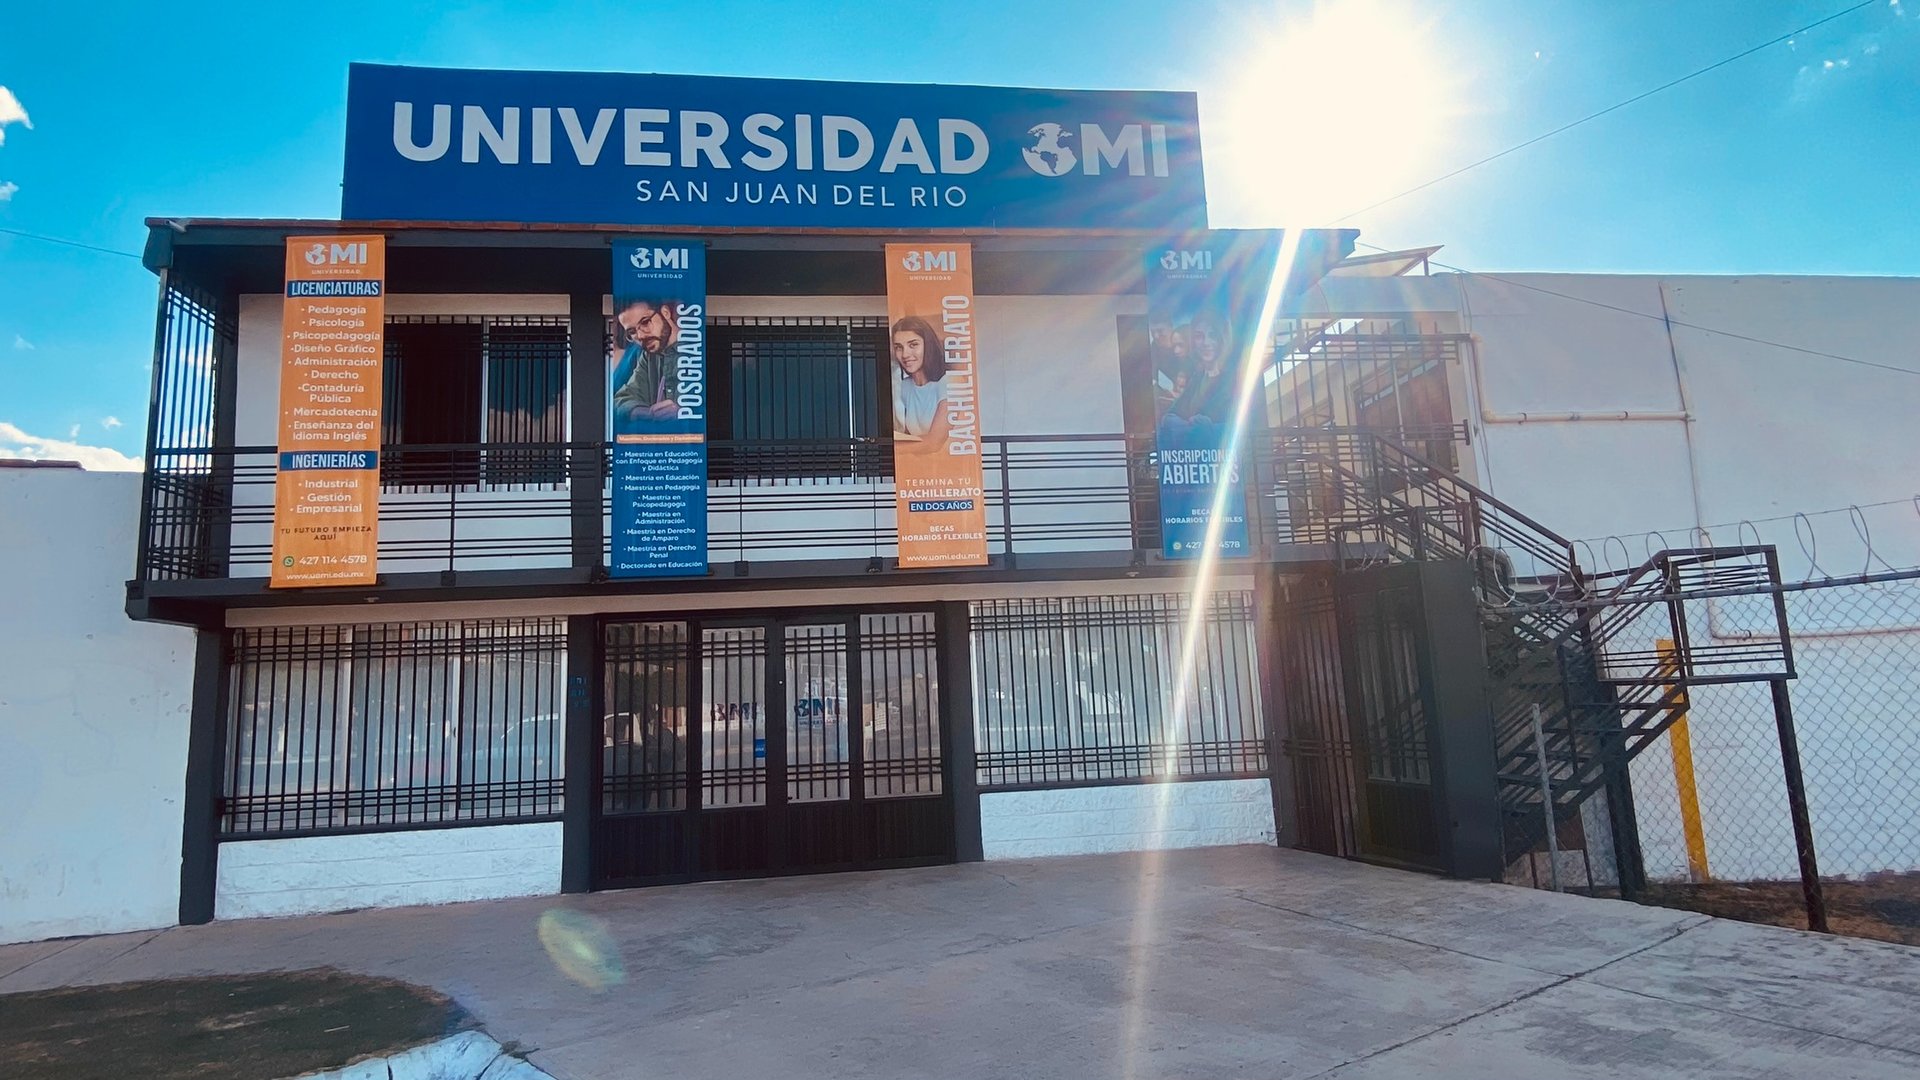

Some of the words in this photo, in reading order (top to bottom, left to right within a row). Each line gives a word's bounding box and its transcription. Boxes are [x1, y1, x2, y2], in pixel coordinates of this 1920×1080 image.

[392, 101, 990, 175] UNIVERSIDAD
[636, 179, 709, 202] SAN
[725, 182, 817, 205] JUAN
[833, 184, 895, 207] DEL
[911, 186, 967, 207] RIO
[291, 281, 379, 295] LICENCIATURAS
[308, 305, 366, 315] Pedagogía
[309, 318, 365, 328] Psicología
[293, 331, 380, 341] Psicopedagogía
[294, 344, 331, 353] Diseño
[335, 343, 375, 353] Gráfico
[294, 357, 377, 366] Administración
[676, 303, 703, 420] POSGRADOS
[311, 370, 359, 379] Derecho
[942, 295, 976, 456] BACHILLERATO
[301, 383, 364, 393] Contaduría
[309, 394, 351, 403] Pública
[293, 421, 353, 430] Enseñanza
[356, 421, 374, 430] del
[293, 431, 330, 440] Idioma
[332, 431, 367, 442] Inglés
[292, 451, 366, 468] INGENIERÍAS
[1162, 463, 1240, 485] ABIERTS
[305, 480, 358, 488] Industrial
[905, 478, 954, 487] TERMINA
[958, 477, 971, 485] TU
[307, 492, 352, 502] Gestión
[900, 487, 981, 498] BACHILLERATO
[296, 504, 362, 514] Empresarial
[910, 503, 923, 511] EN
[925, 502, 945, 511] DOS
[946, 500, 973, 510] AÑOS
[929, 525, 955, 533] BECAS
[299, 556, 319, 565] 427
[321, 556, 337, 564] 114
[340, 555, 367, 564] 4578
